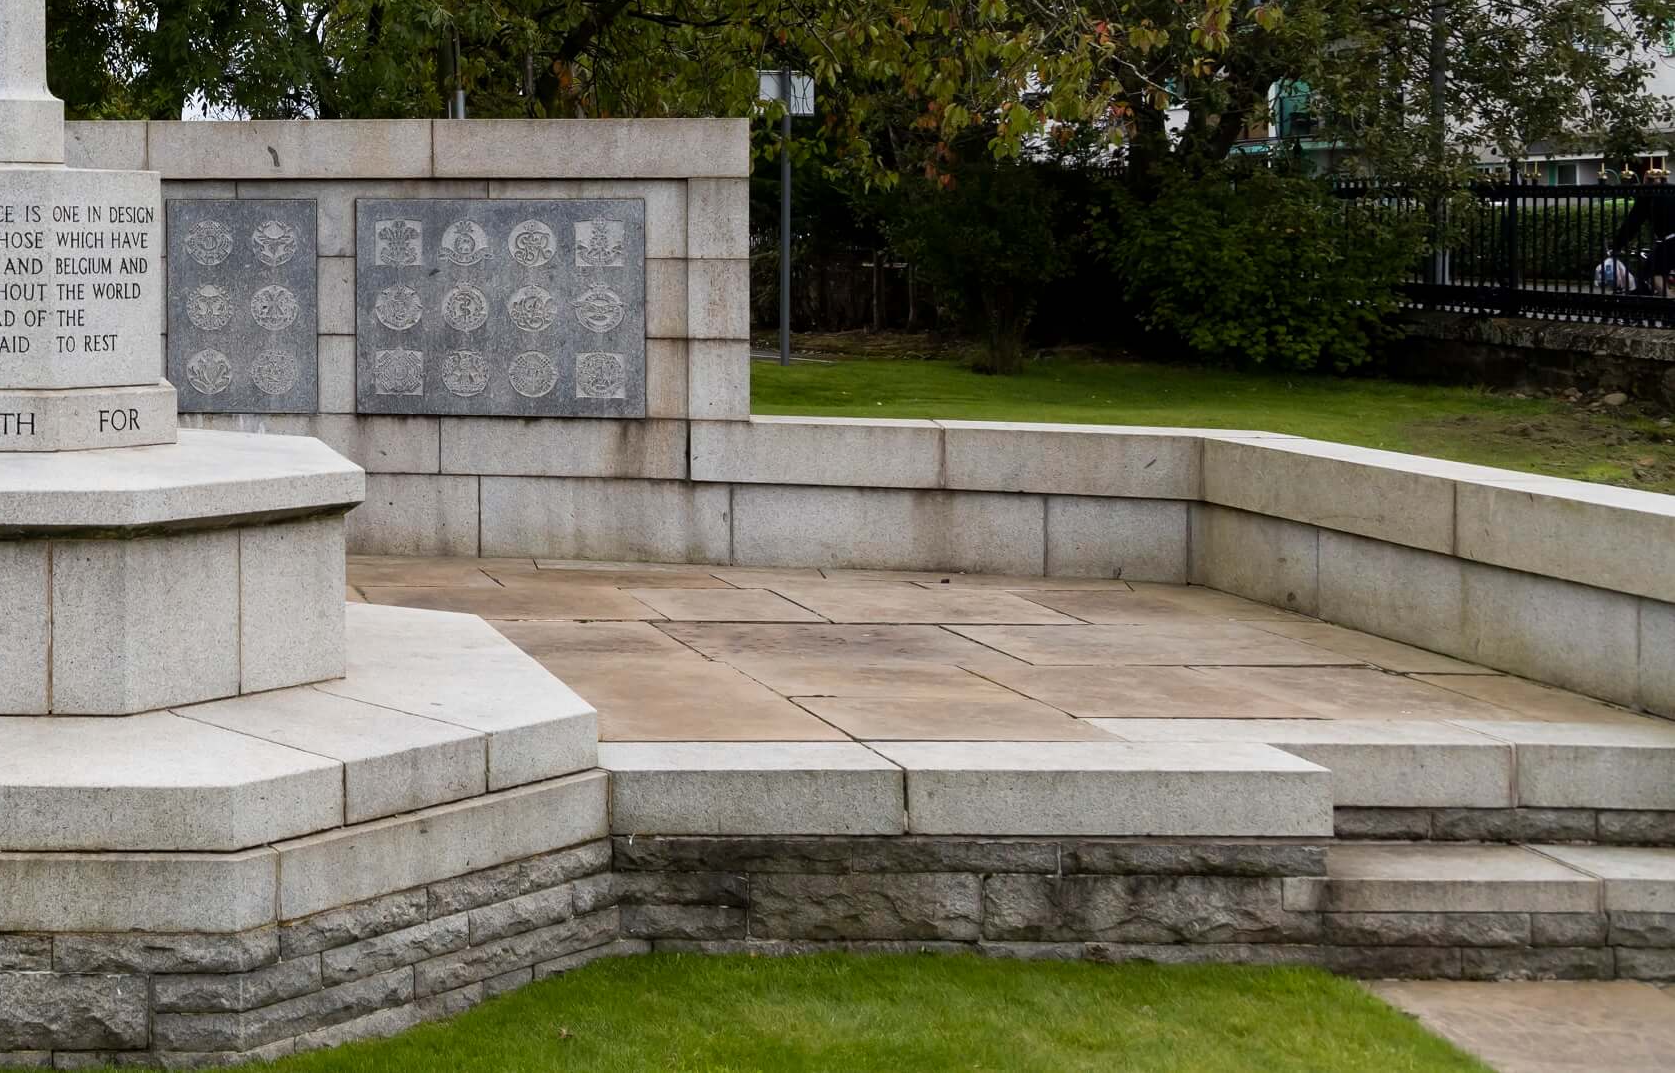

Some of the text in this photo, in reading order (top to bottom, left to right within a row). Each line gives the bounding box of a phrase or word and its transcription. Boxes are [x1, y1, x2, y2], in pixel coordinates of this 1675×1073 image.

[26, 206, 41, 222] IS
[53, 206, 80, 222] ONE
[88, 206, 101, 222] IN
[110, 207, 153, 223] DESIGN
[56, 232, 103, 249] WHICH
[112, 232, 148, 249] HAVE
[4, 258, 43, 275] AND
[56, 257, 111, 275] BELGIUM
[120, 258, 147, 274] AND
[56, 284, 84, 300] THE
[93, 283, 140, 299] WORLD
[24, 310, 47, 327] OF
[57, 309, 84, 326] THE
[56, 336, 75, 353] TO
[85, 334, 117, 352] REST
[98, 409, 140, 432] FOR
